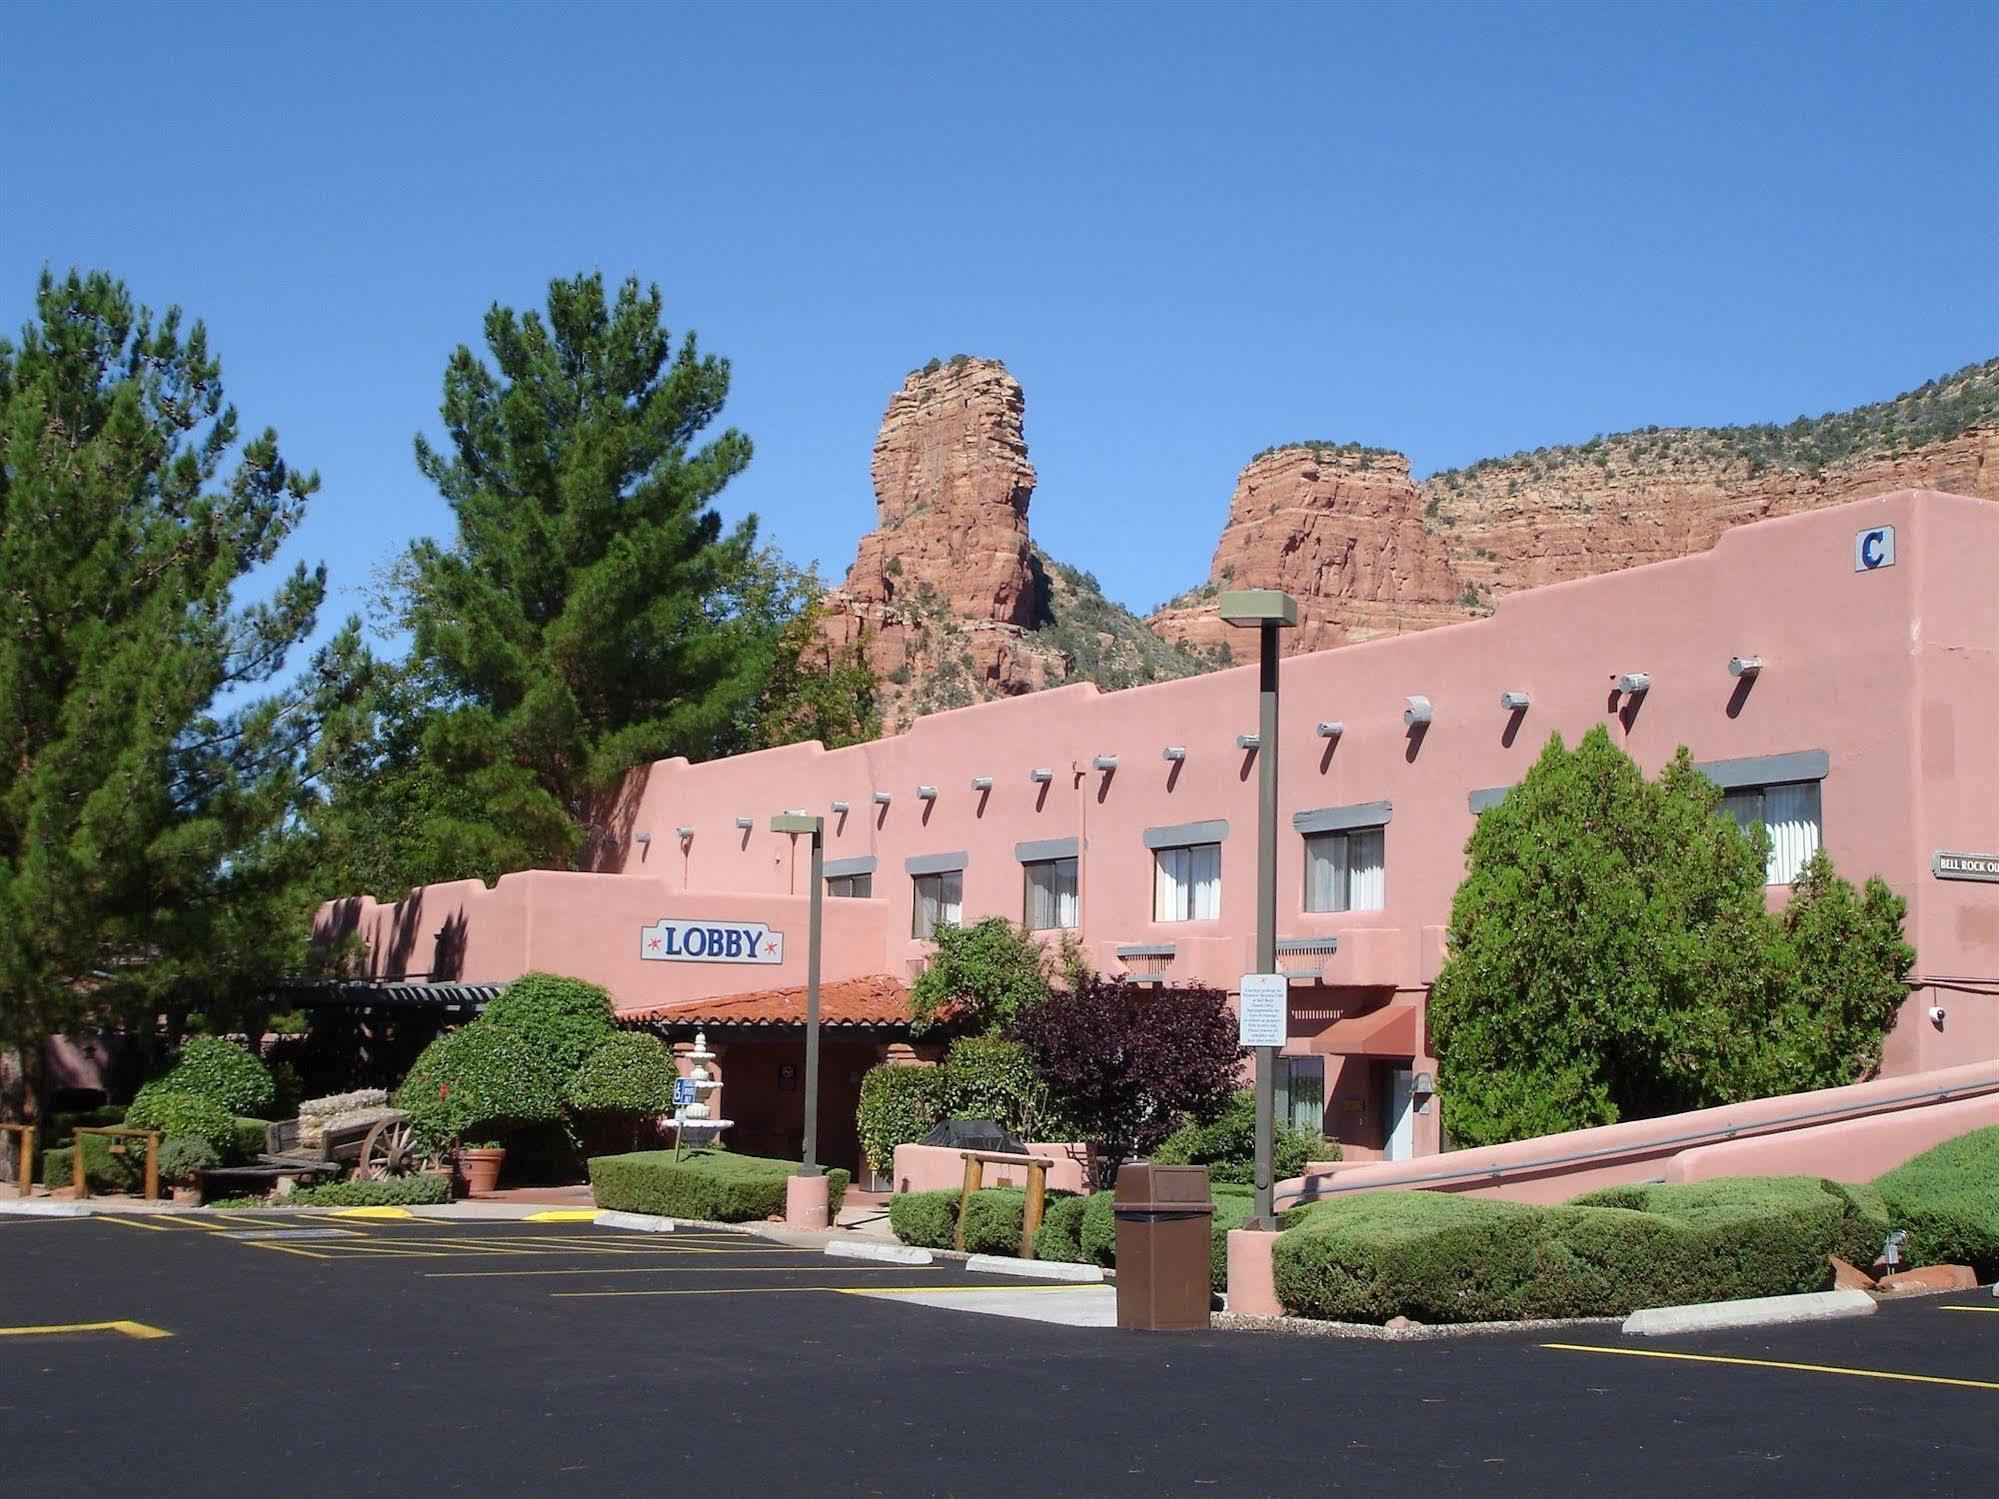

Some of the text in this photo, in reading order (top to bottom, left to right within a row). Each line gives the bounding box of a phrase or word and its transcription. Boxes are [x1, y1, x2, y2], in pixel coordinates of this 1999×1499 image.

[1862, 531, 1884, 569] C
[1941, 858, 1960, 870] BELL
[1961, 860, 1986, 872] ROCK
[665, 927, 763, 957] LOBBY
